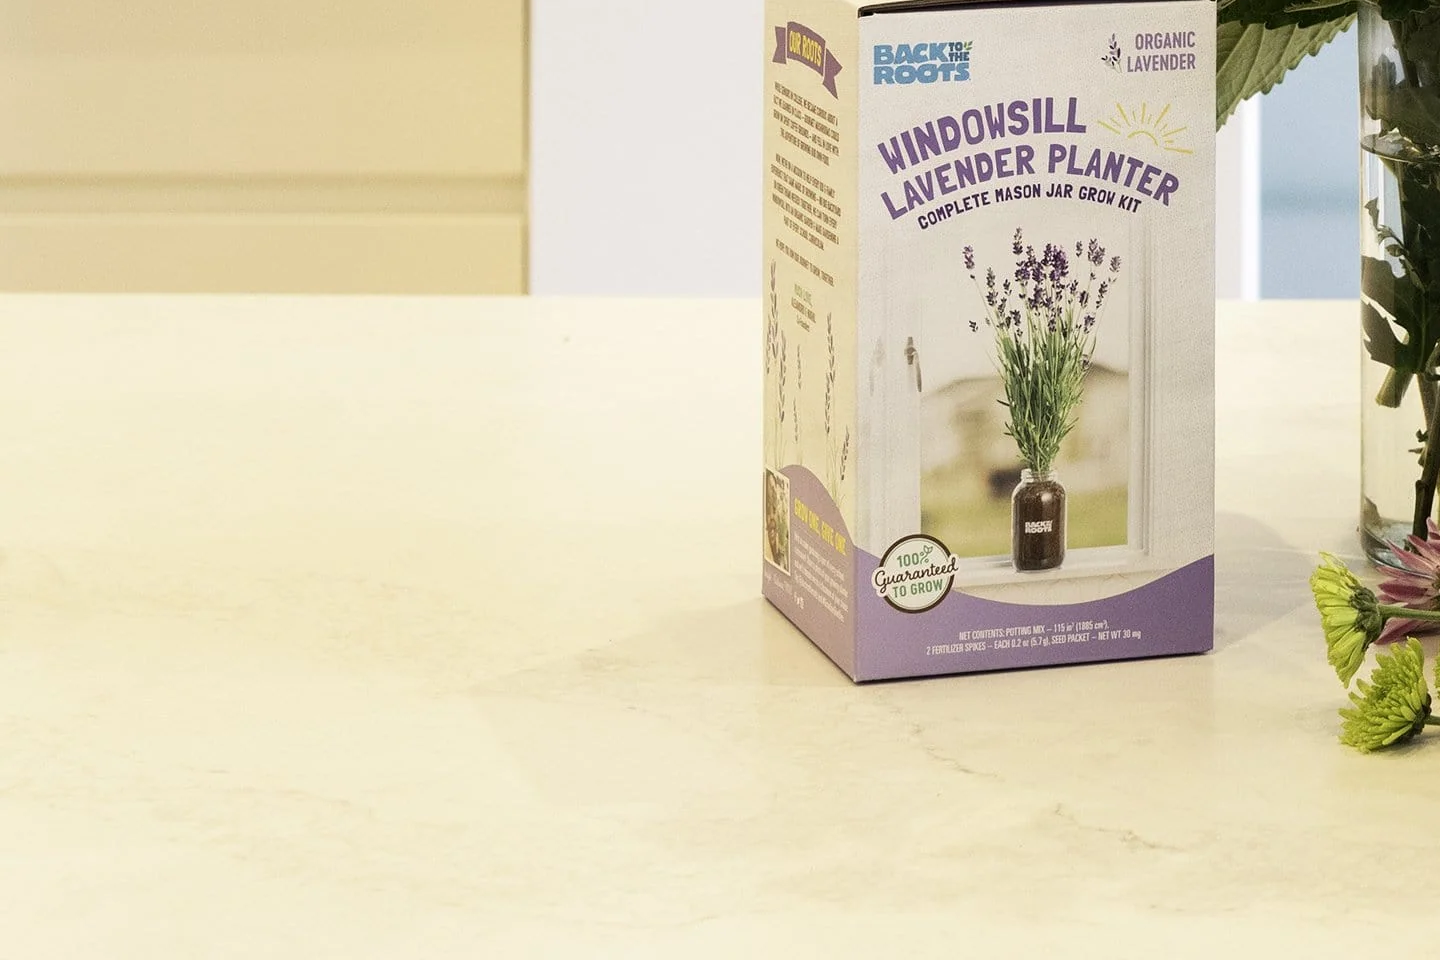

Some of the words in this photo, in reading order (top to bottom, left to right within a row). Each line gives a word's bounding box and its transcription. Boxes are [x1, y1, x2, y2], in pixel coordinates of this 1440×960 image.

[790, 30, 801, 56] OUR
[802, 34, 822, 67] ROOTS
[1135, 31, 1196, 51] ORGANIC
[873, 42, 949, 65] BACK
[948, 41, 963, 52] TO
[948, 51, 970, 62] THE
[1127, 53, 1196, 73] LAVENDER
[873, 62, 970, 85] ROOTS
[877, 97, 1087, 175] WINDOWSILL
[880, 144, 1036, 220] LAVENDER
[1047, 143, 1180, 207] PLANTER
[917, 191, 991, 230] COMPLETE
[995, 183, 1041, 203] MASON
[1045, 183, 1074, 199] JAR
[1078, 186, 1116, 205] GROW
[1118, 194, 1142, 213] KIT
[896, 545, 933, 568] 100%
[875, 557, 959, 594] Guaranteed
[892, 585, 907, 598] TO
[910, 579, 943, 596] GROW
[926, 646, 931, 656] 2
[931, 643, 964, 656] FERTILIZER
[964, 641, 987, 652] SPIKES
[994, 639, 1011, 650] EACH
[1051, 634, 1067, 645] SEED
[1067, 632, 1090, 644] PACKET
[1098, 631, 1110, 641] NET
[1110, 629, 1122, 640] WT
[959, 631, 971, 641] NET
[1005, 625, 1032, 637] POTTING
[1032, 624, 1046, 635] MIX
[1053, 623, 1066, 633] 115
